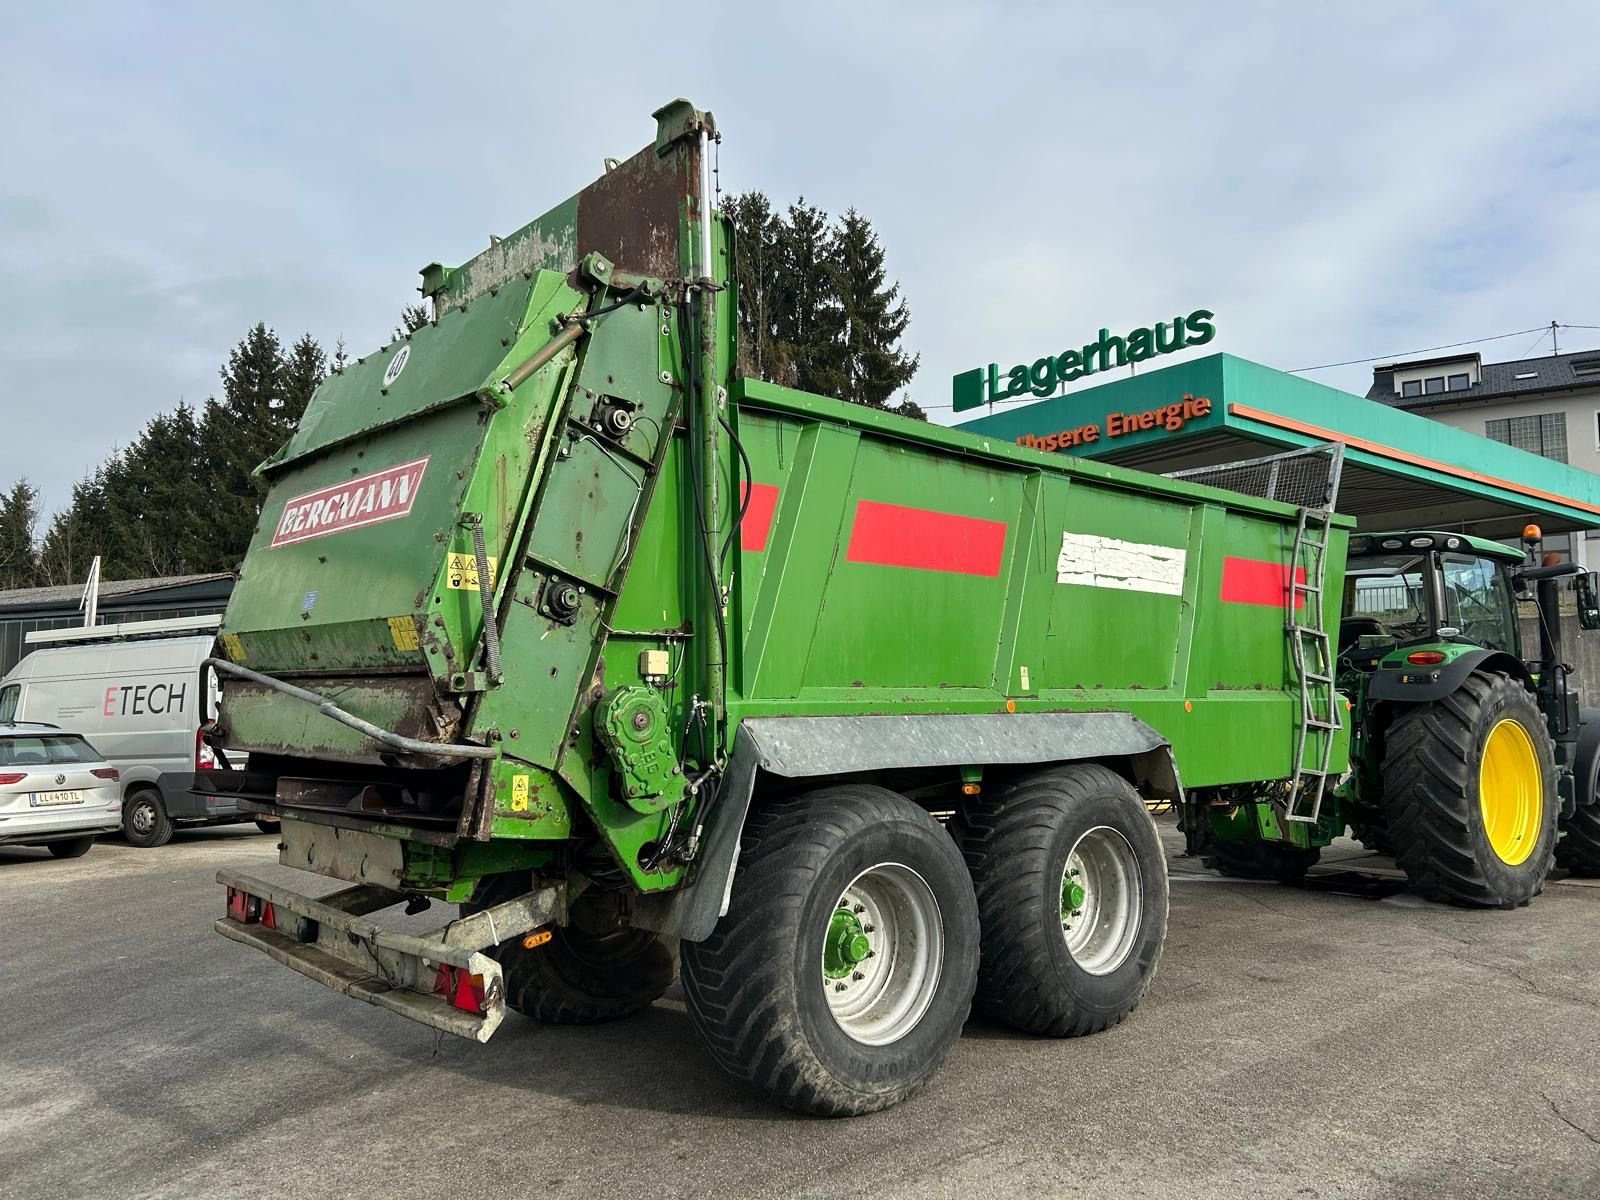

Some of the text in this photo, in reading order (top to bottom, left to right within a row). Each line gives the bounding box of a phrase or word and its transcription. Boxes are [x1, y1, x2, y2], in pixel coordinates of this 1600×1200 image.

[387, 350, 408, 379] 40
[988, 309, 1216, 402] Lagerhaus
[1106, 393, 1212, 437] Energie
[278, 471, 417, 536] BERGMANN
[103, 682, 187, 717] ETECH
[39, 793, 49, 803] LL
